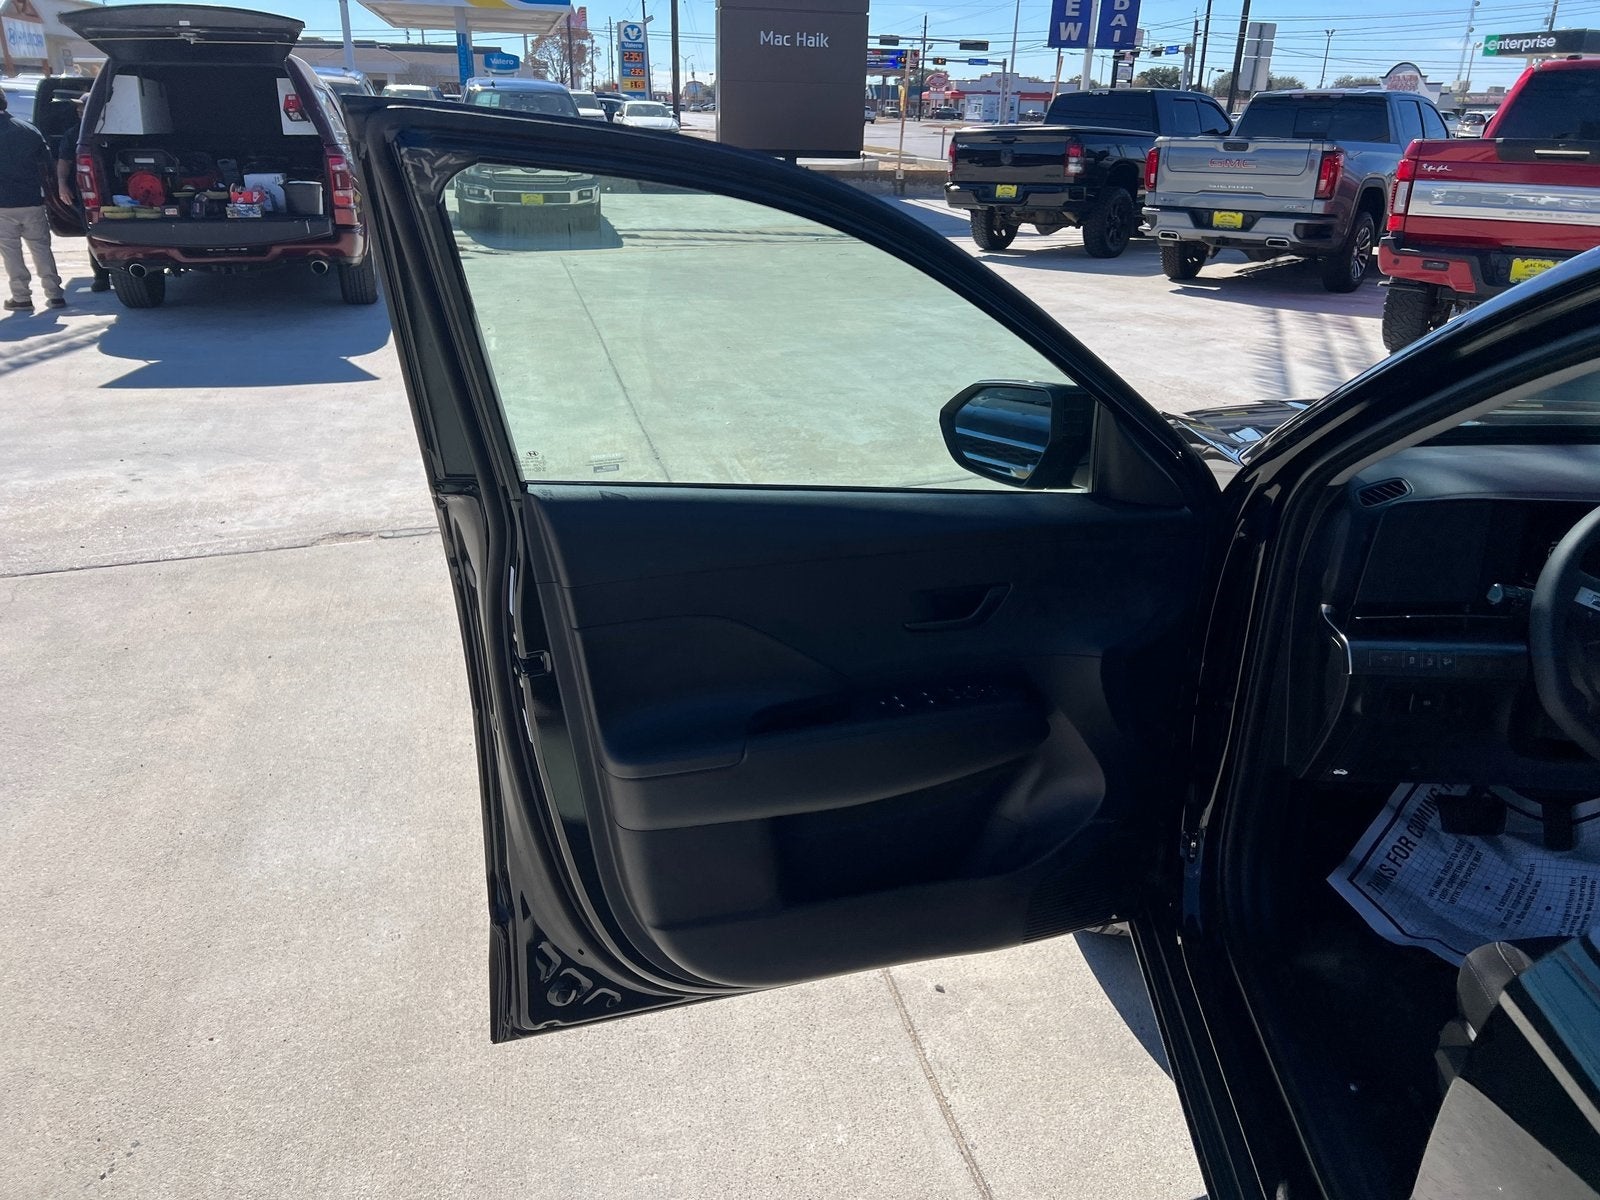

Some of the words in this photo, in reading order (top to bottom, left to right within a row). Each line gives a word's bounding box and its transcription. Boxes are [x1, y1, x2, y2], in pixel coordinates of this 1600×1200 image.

[760, 30, 791, 46] Mac
[796, 32, 829, 48] Haik
[1486, 35, 1556, 52] enterprise
[1208, 159, 1257, 168] GMC
[1385, 835, 1418, 867] FOR
